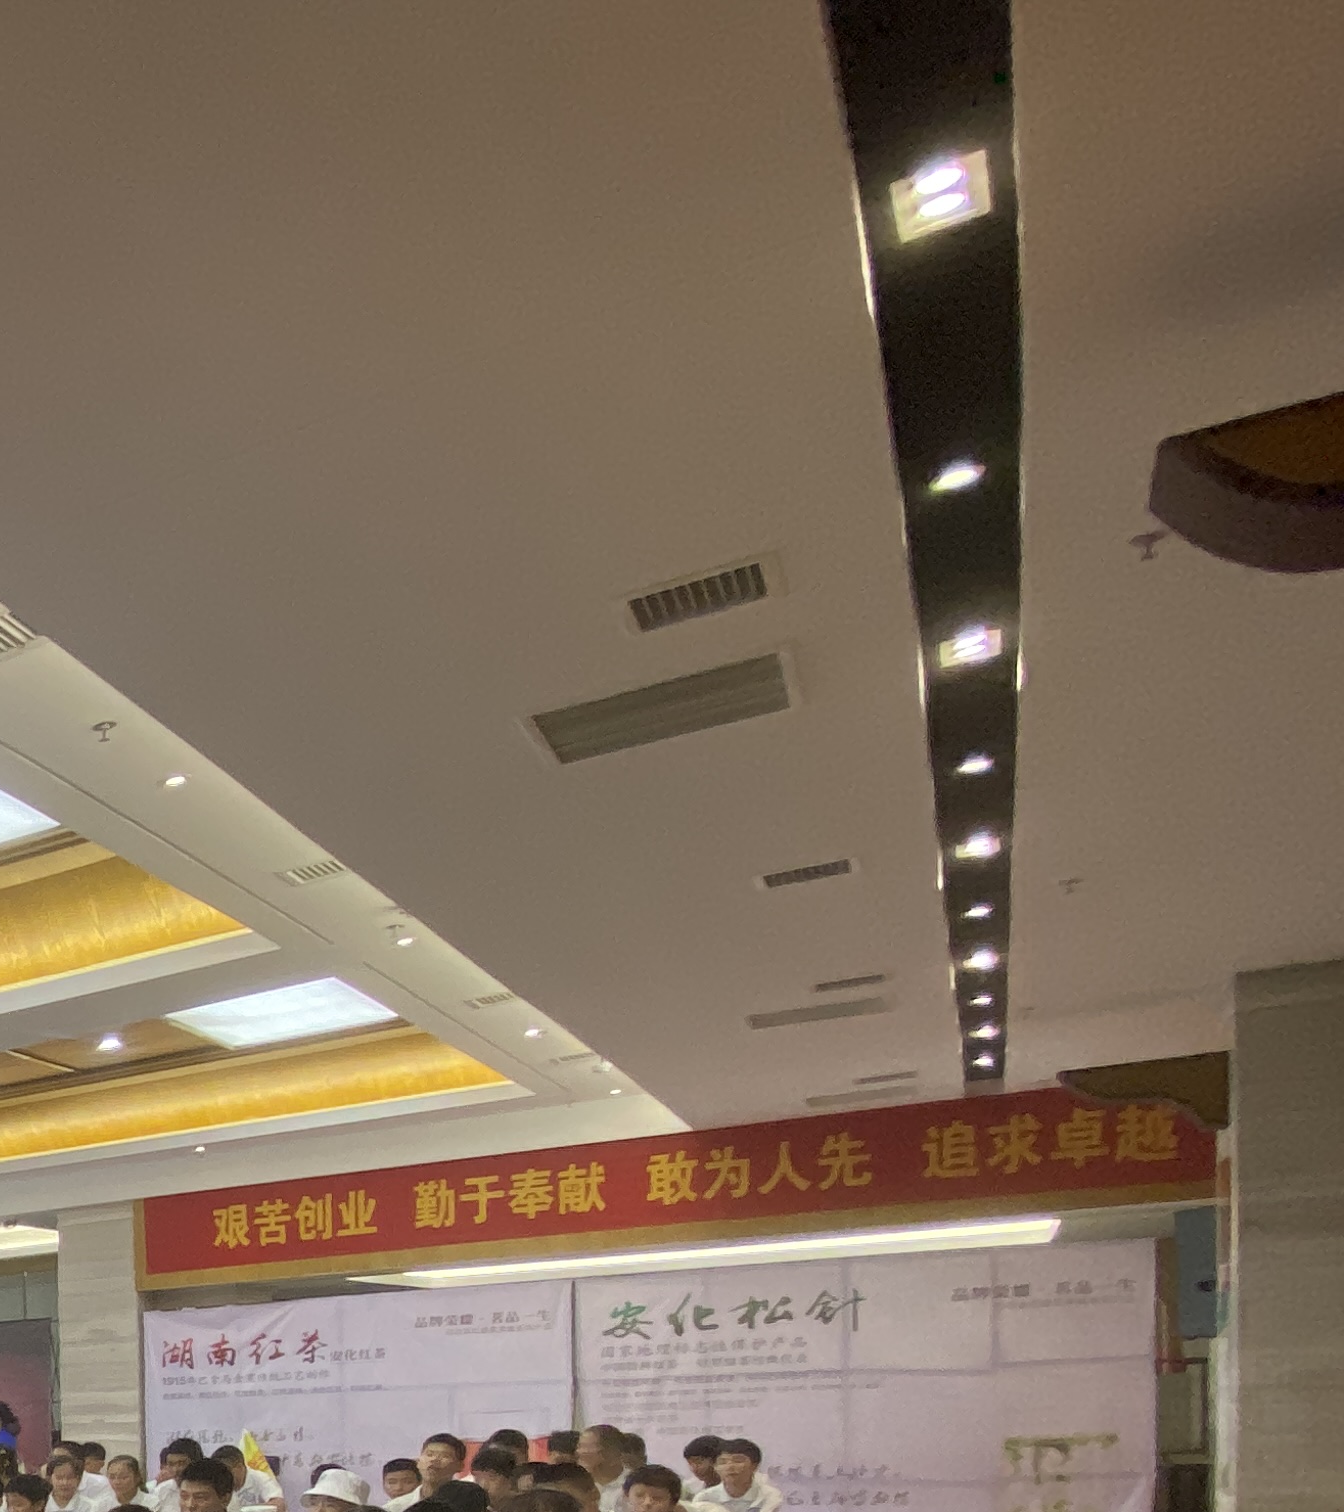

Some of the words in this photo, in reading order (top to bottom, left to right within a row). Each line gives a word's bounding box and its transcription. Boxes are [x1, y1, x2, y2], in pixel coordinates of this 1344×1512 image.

[213, 1190, 379, 1249] 艰苦创业
[414, 1162, 607, 1229] 勤于奉献
[646, 1132, 874, 1206] 敢为人先
[921, 1103, 1180, 1180] 追求卓越
[602, 1288, 867, 1340] 安化松针
[161, 1329, 328, 1369] 湖南红茶
